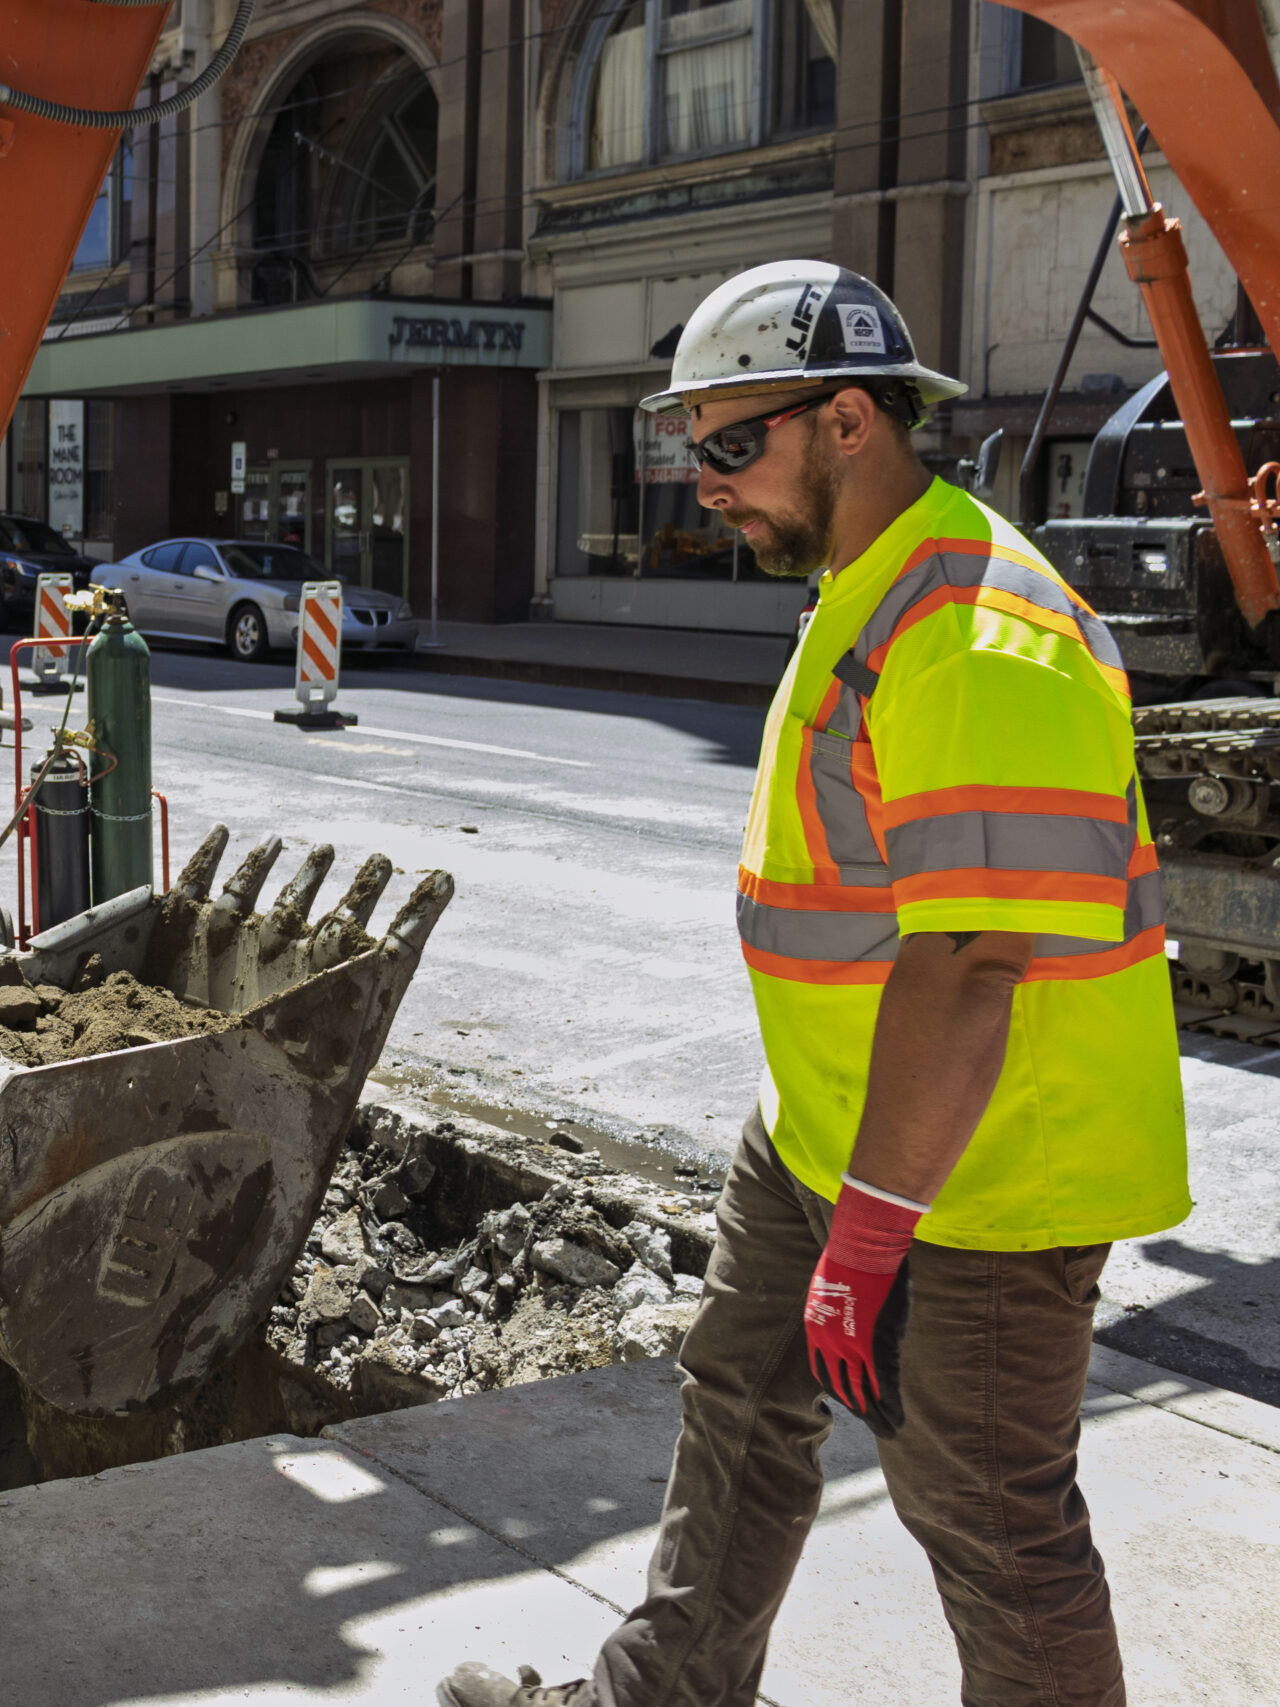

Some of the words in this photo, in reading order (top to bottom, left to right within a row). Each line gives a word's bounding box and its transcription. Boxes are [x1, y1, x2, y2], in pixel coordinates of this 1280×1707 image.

[785, 283, 822, 360] LIFT
[388, 316, 526, 351] JERMYN
[57, 424, 76, 442] THE
[655, 421, 688, 436] FOR
[52, 446, 80, 463] MANE
